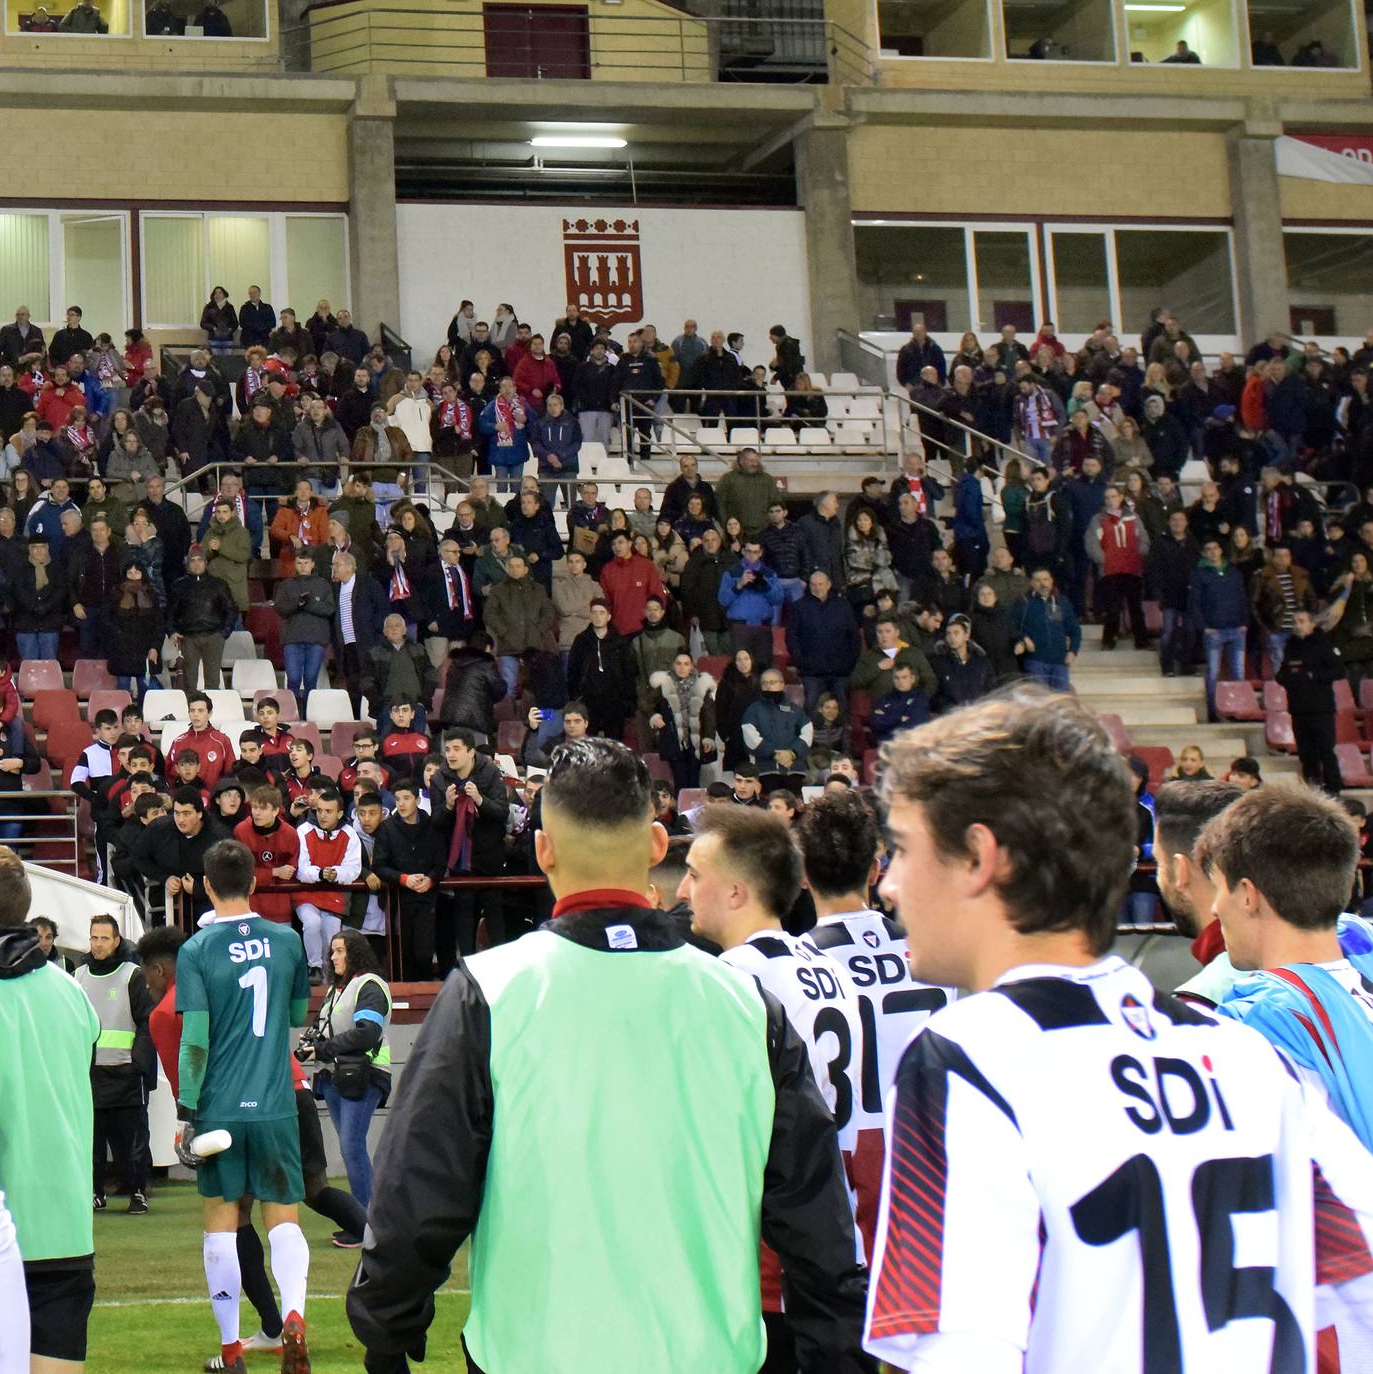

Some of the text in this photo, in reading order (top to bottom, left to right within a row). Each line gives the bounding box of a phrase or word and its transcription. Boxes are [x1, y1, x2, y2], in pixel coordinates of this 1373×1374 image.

[228, 937, 271, 964] SDi
[795, 966, 846, 1001] SDi
[238, 965, 268, 1038] 1
[1109, 1053, 1236, 1136] SDi
[1068, 1152, 1309, 1374] 15
